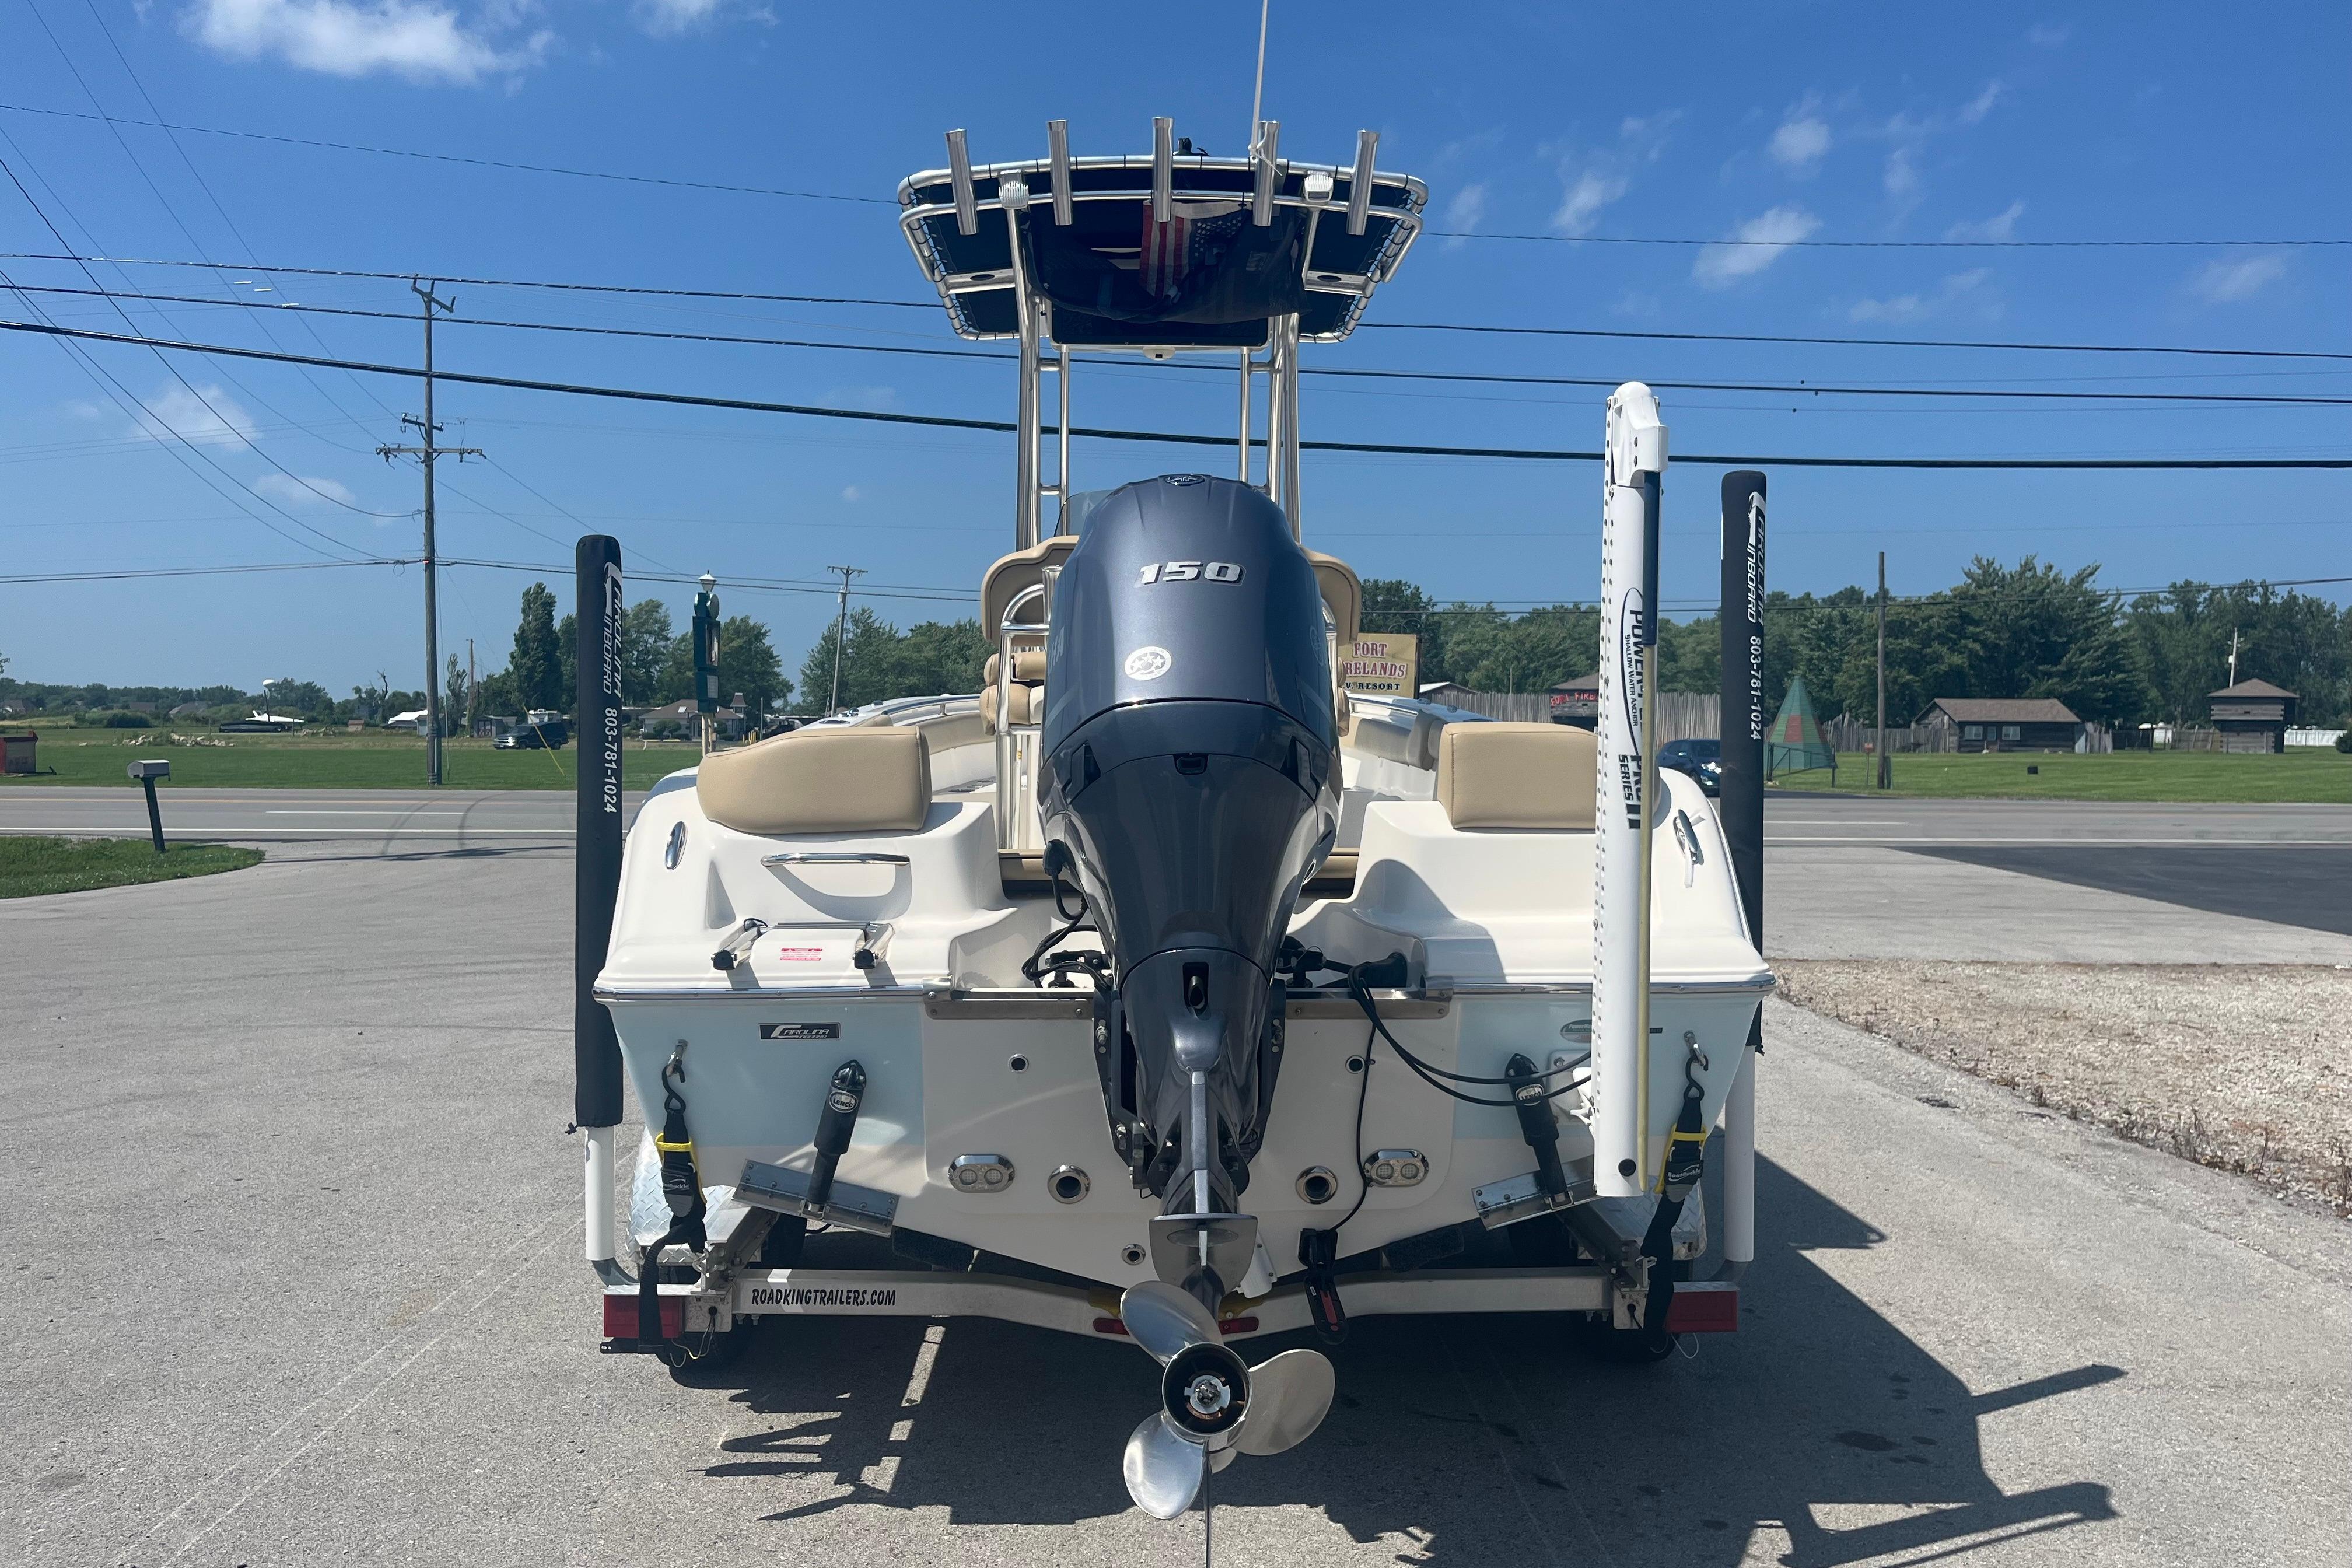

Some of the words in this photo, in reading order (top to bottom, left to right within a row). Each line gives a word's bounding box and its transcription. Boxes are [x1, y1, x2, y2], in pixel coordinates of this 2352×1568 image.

[1140, 561, 1242, 584] 150
[604, 614, 612, 694] INBOARD
[1354, 643, 1387, 657] FORT
[1625, 634, 1633, 668] SHALLOW
[1343, 662, 1405, 677] RELANDS
[1358, 682, 1401, 691] RESORT
[1750, 635, 1761, 740] 803-781-1024
[604, 708, 618, 813] 803-781-1024
[1619, 754, 1634, 801] SERIES
[771, 1024, 830, 1039] CAROLINA
[833, 1098, 853, 1108] LENCO
[752, 1289, 896, 1306] ROADKINGTRAILERS.COM
